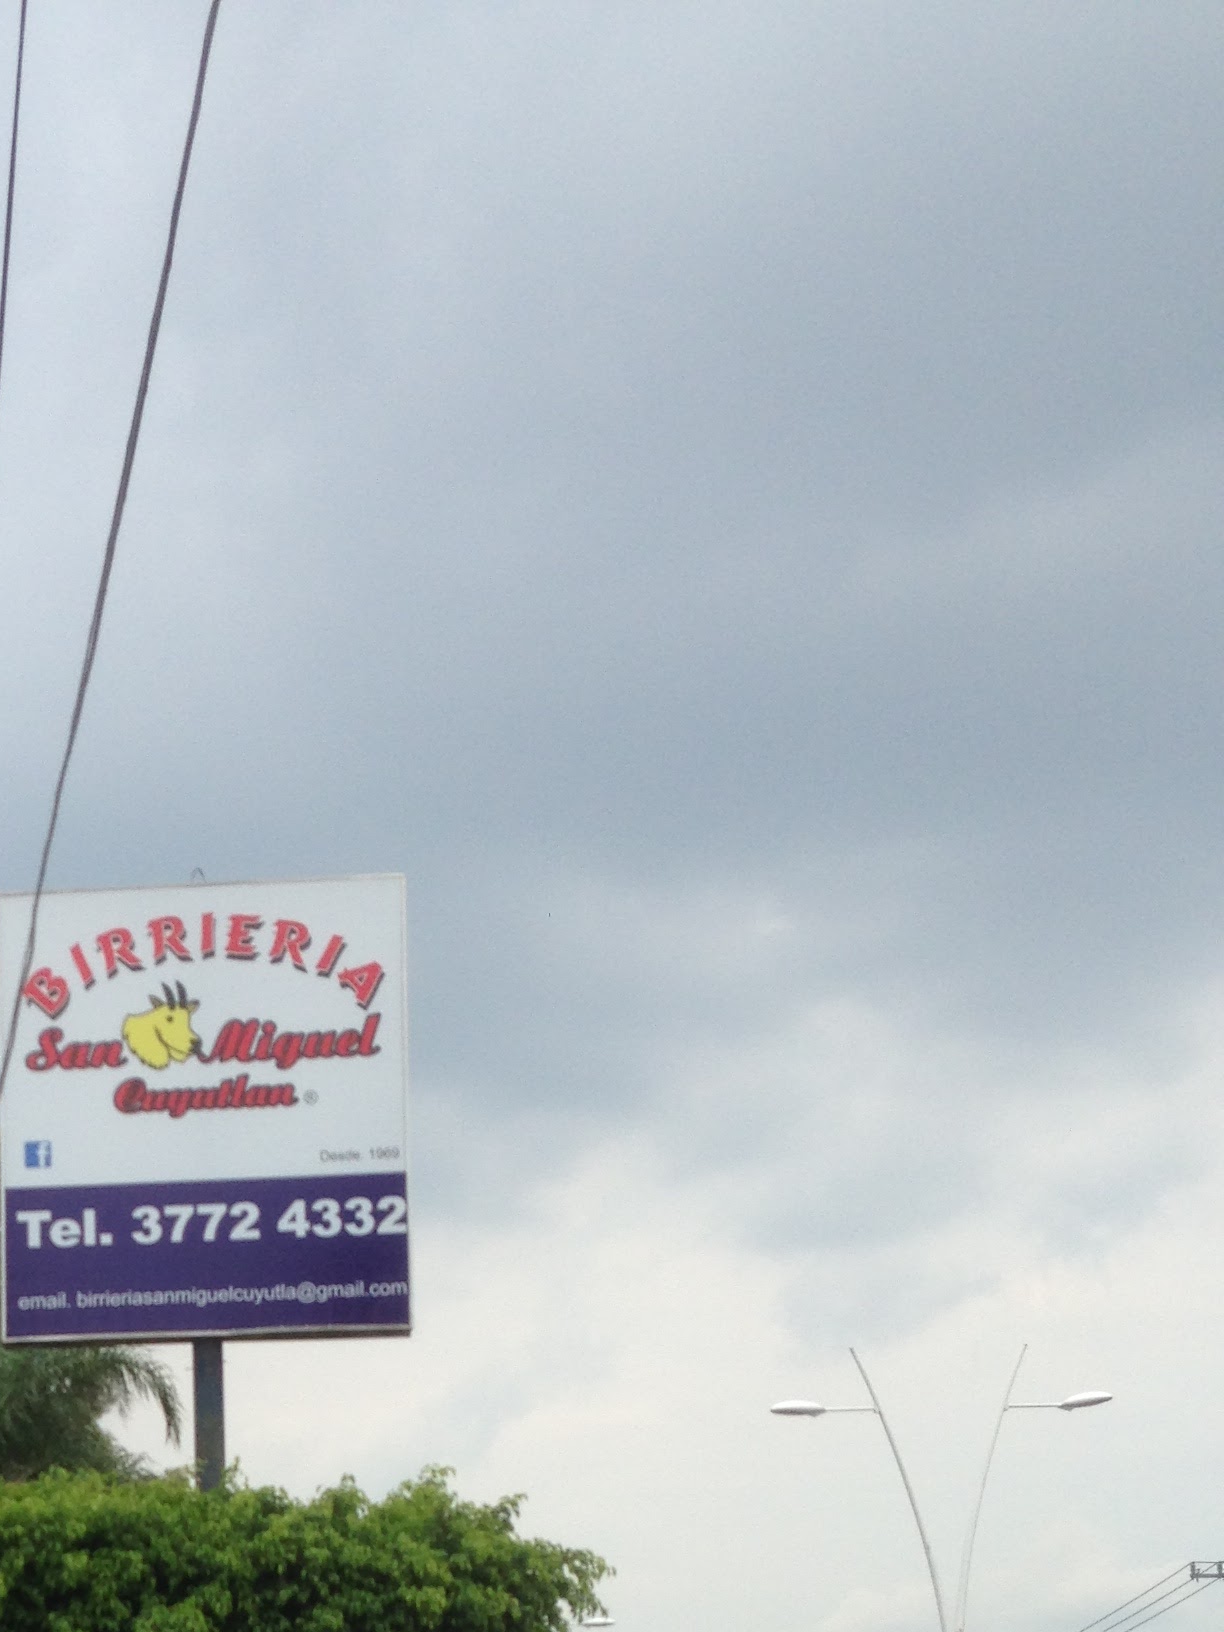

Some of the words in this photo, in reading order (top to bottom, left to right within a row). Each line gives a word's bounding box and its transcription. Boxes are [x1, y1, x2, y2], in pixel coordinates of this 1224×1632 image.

[23, 912, 384, 1018] BIRRIERIA
[26, 1027, 128, 1071] San
[200, 1013, 381, 1069] Miguel
[114, 1074, 299, 1118] Cuyutlan
[16, 1209, 113, 1249] Tel.
[131, 1201, 261, 1246] 3772
[277, 1196, 408, 1239] 4332
